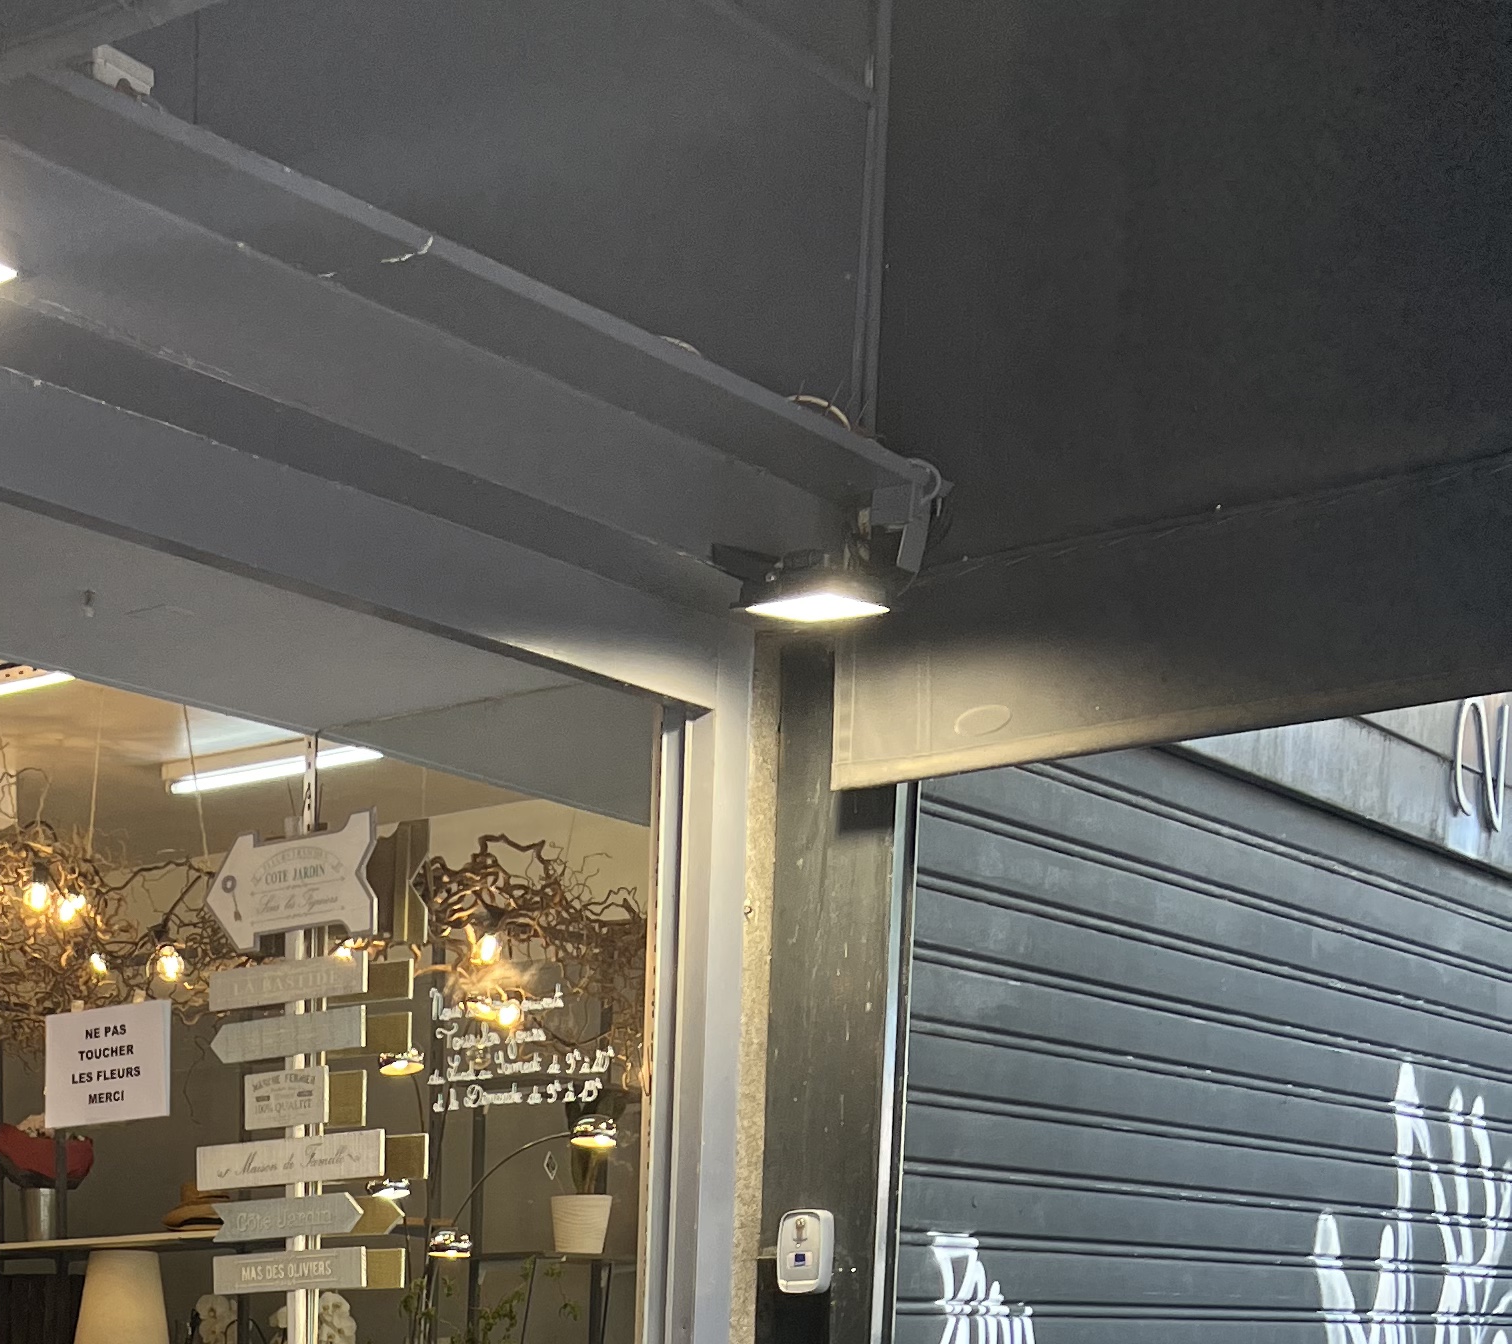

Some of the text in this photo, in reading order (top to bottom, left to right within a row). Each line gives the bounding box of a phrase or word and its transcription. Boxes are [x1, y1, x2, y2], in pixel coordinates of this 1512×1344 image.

[292, 864, 326, 881] JARDIN
[85, 1024, 127, 1040] NE PAS
[78, 1044, 134, 1061] TOUCHER
[71, 1066, 141, 1085] LES FLEURS
[88, 1090, 125, 1104] MERCI
[234, 1150, 278, 1176] Maison
[283, 1153, 295, 1171] de
[277, 1207, 334, 1228] Jardin
[241, 1260, 333, 1281] MAS DES OLIVIERS
